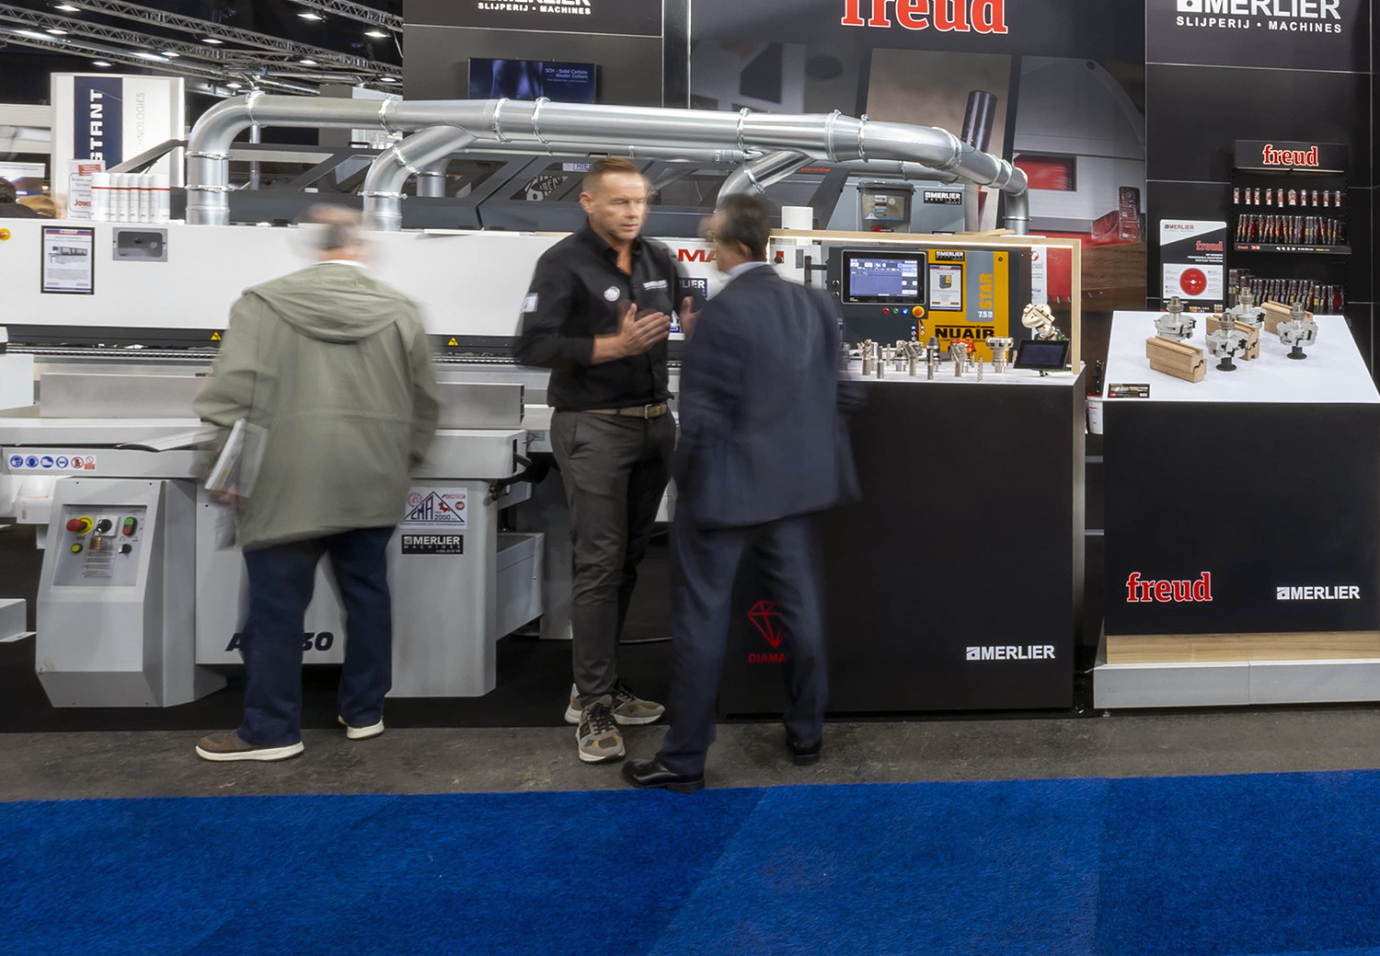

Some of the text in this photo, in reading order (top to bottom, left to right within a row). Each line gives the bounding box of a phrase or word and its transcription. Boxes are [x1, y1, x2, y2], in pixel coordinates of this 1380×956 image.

[478, 2, 591, 15] SLIJPERIJ MACHINES
[1176, 16, 1342, 33] SLIJPERIJ MACHINES
[1263, 144, 1319, 166] freud
[1196, 240, 1223, 251] freud
[979, 273, 993, 309] STAR
[413, 536, 460, 545] MERLIER
[1126, 572, 1212, 602] freud
[1290, 585, 1360, 601] MERLIER
[980, 645, 1056, 661] MERLIER
